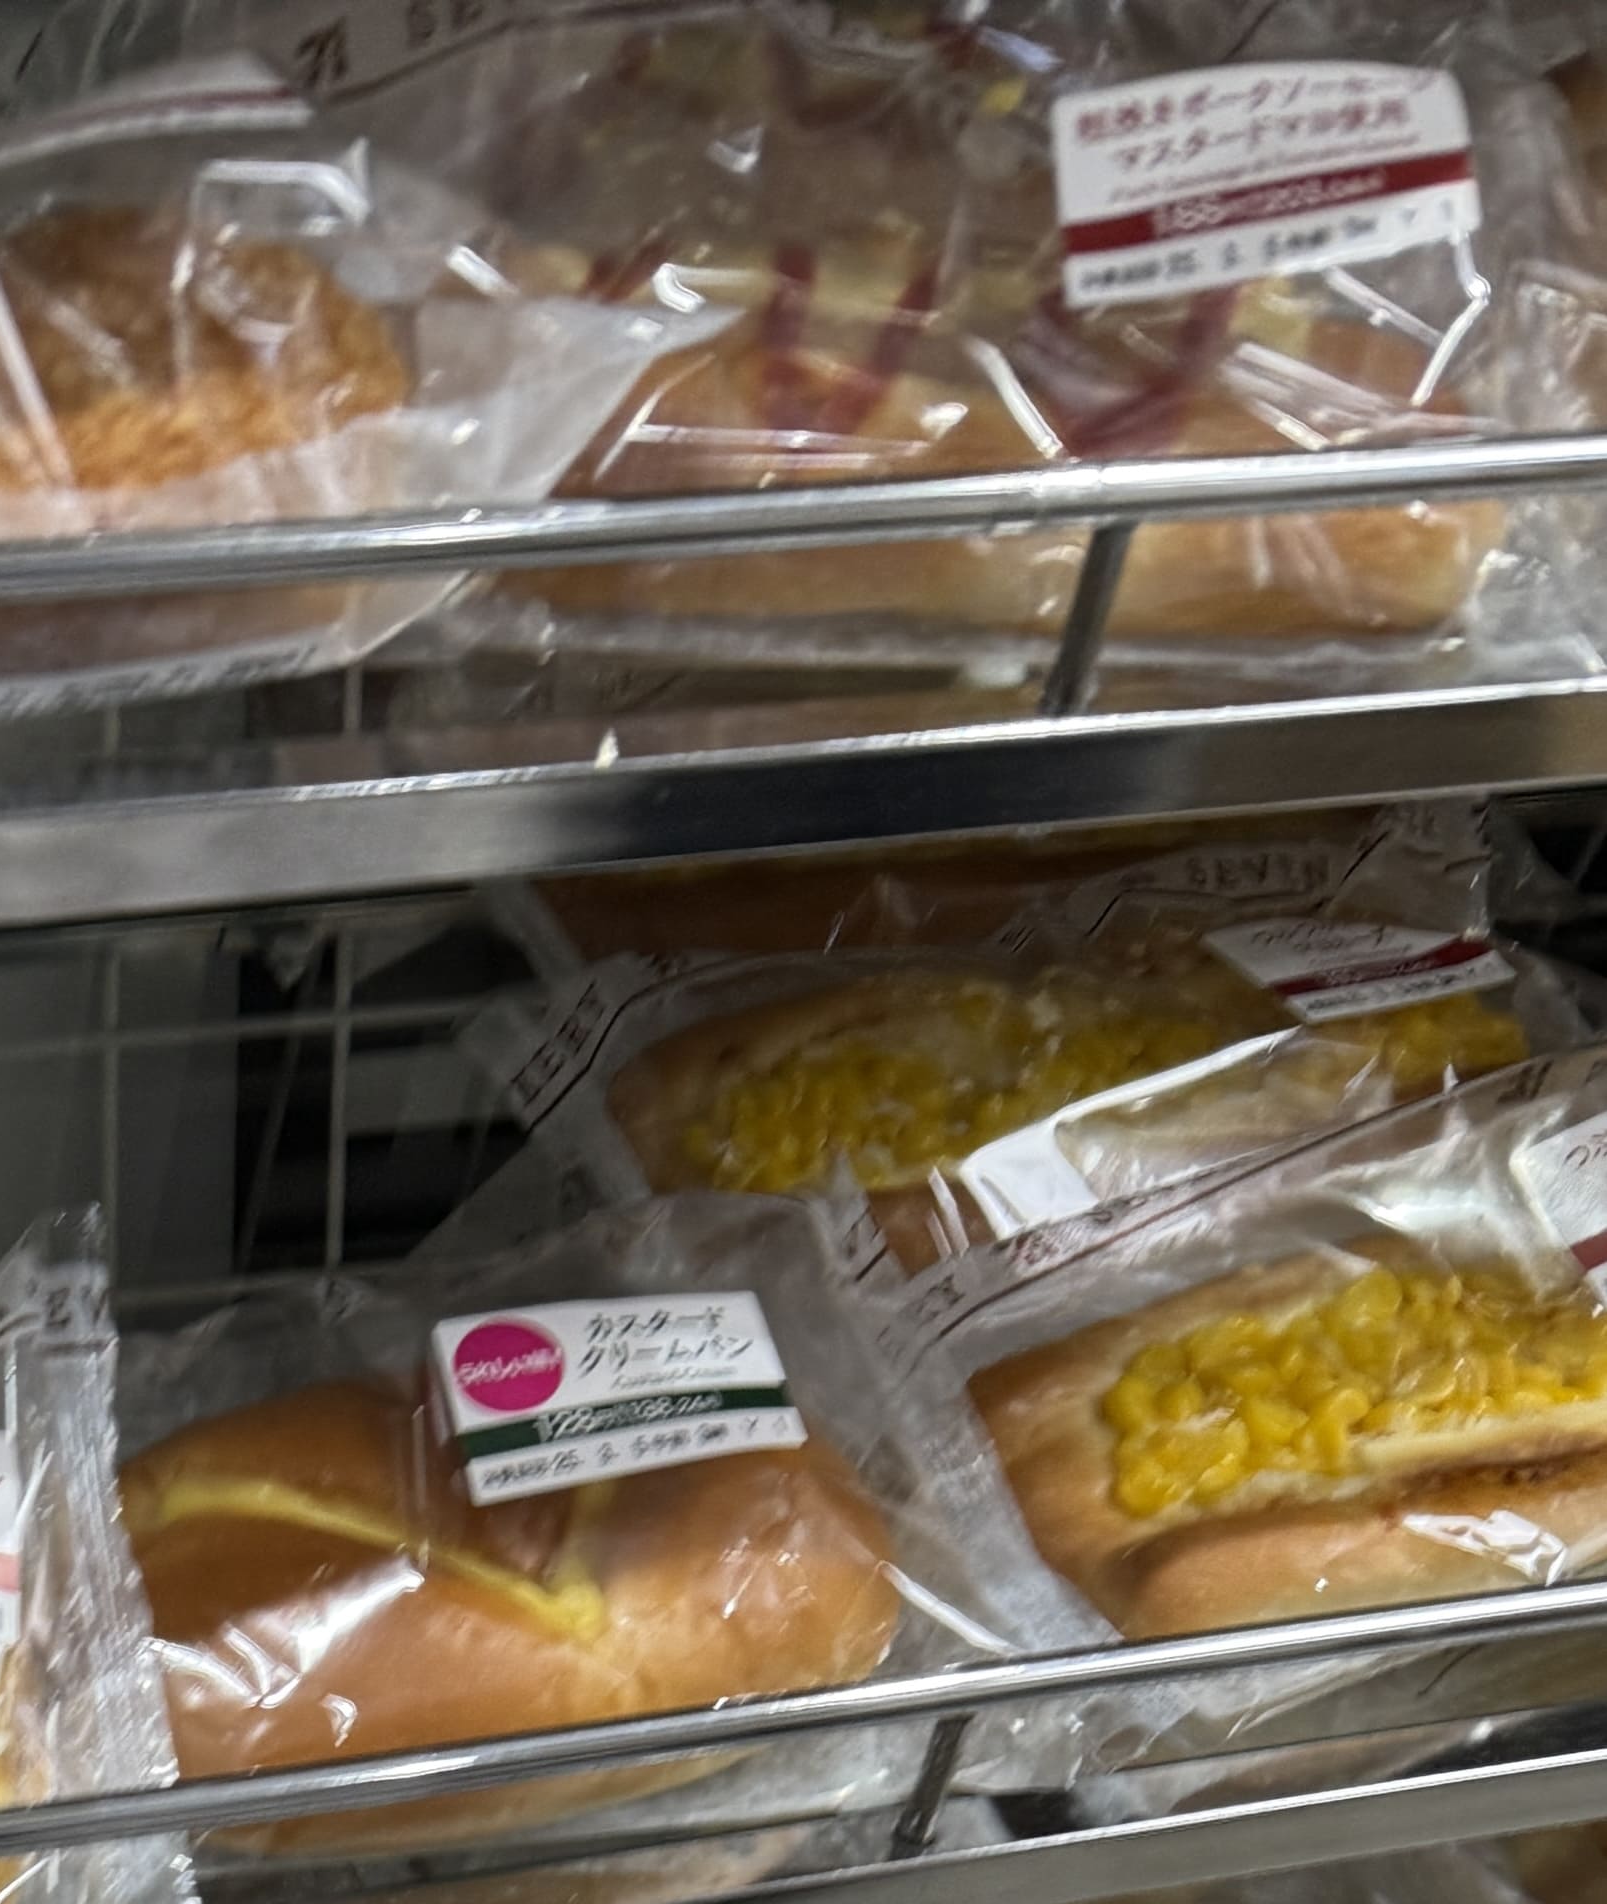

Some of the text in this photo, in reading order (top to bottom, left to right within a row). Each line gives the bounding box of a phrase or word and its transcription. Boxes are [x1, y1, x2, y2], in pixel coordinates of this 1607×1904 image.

[578, 1338, 754, 1378] クリームパン
